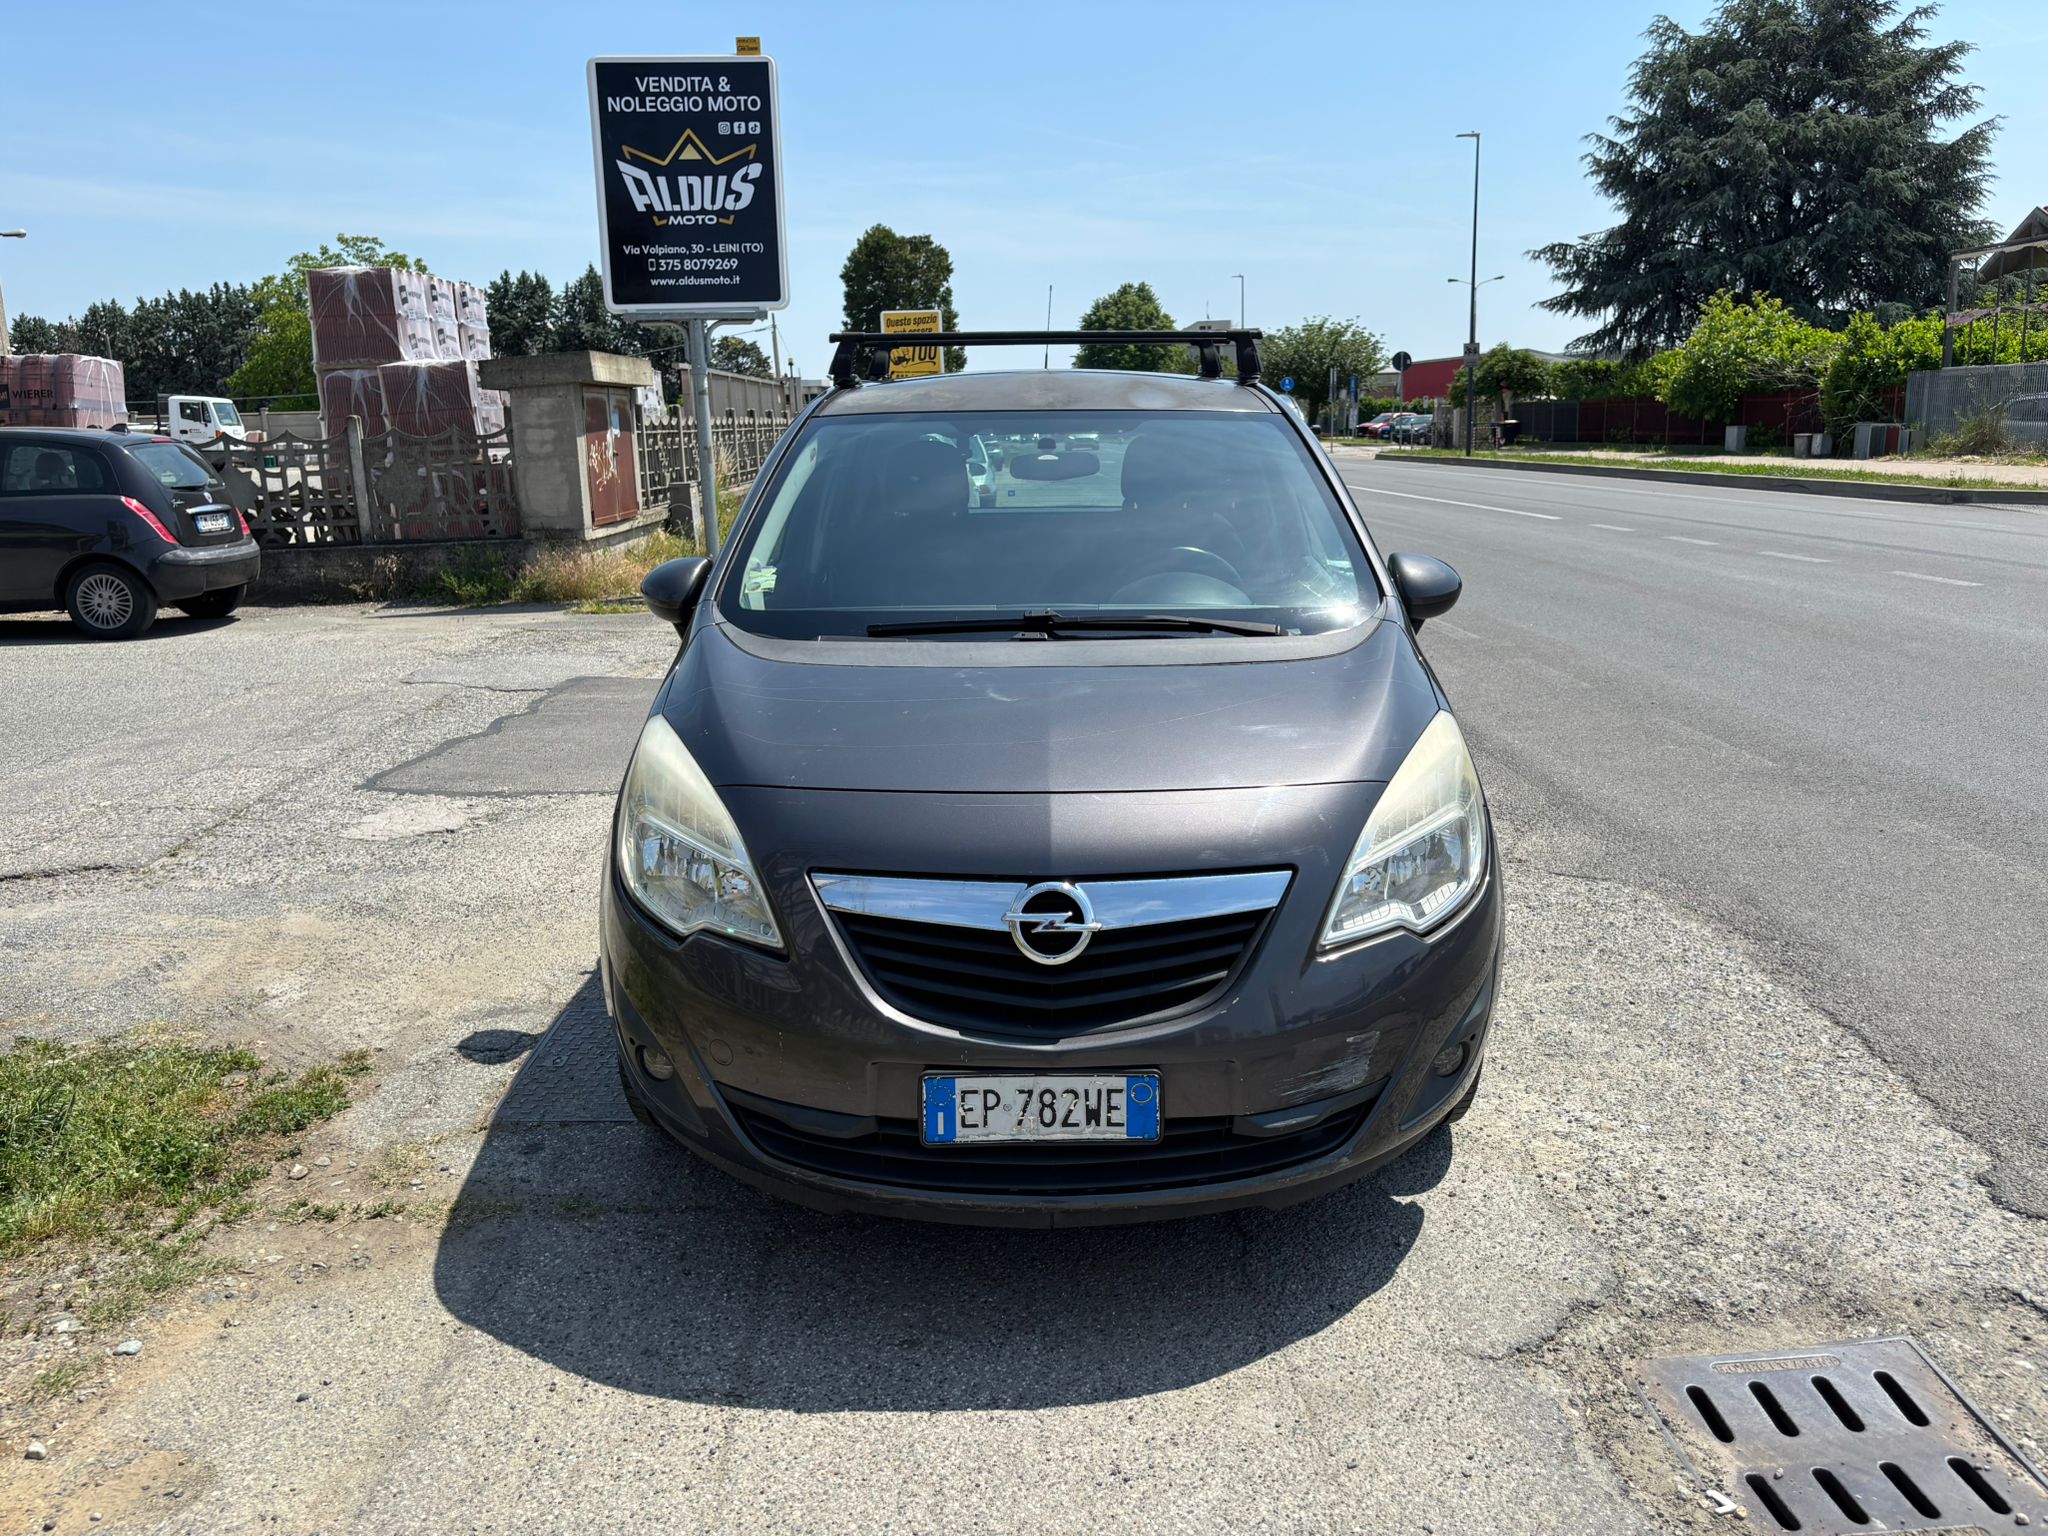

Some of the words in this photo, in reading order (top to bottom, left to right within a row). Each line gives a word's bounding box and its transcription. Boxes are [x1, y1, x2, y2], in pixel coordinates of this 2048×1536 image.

[635, 76, 714, 93] VENDITA
[718, 76, 731, 93] &
[607, 96, 703, 113] NOLEGGIO
[707, 96, 761, 112] MOTO
[615, 159, 763, 212] ALDUS
[668, 215, 717, 225] MOTO
[623, 245, 640, 255] Via
[641, 244, 689, 256] Volpiano,
[691, 244, 704, 254] 30
[713, 243, 740, 253] LEINI
[741, 243, 764, 254] (TO)
[659, 259, 681, 271] 375
[683, 258, 739, 271] 8079269
[650, 275, 740, 286] www.aldusmoto.it
[886, 316, 912, 328] Questo
[912, 314, 937, 327] spazio
[11, 389, 54, 400] WIERER
[959, 1087, 1001, 1129] EP
[1014, 1087, 1126, 1129] 782WE
